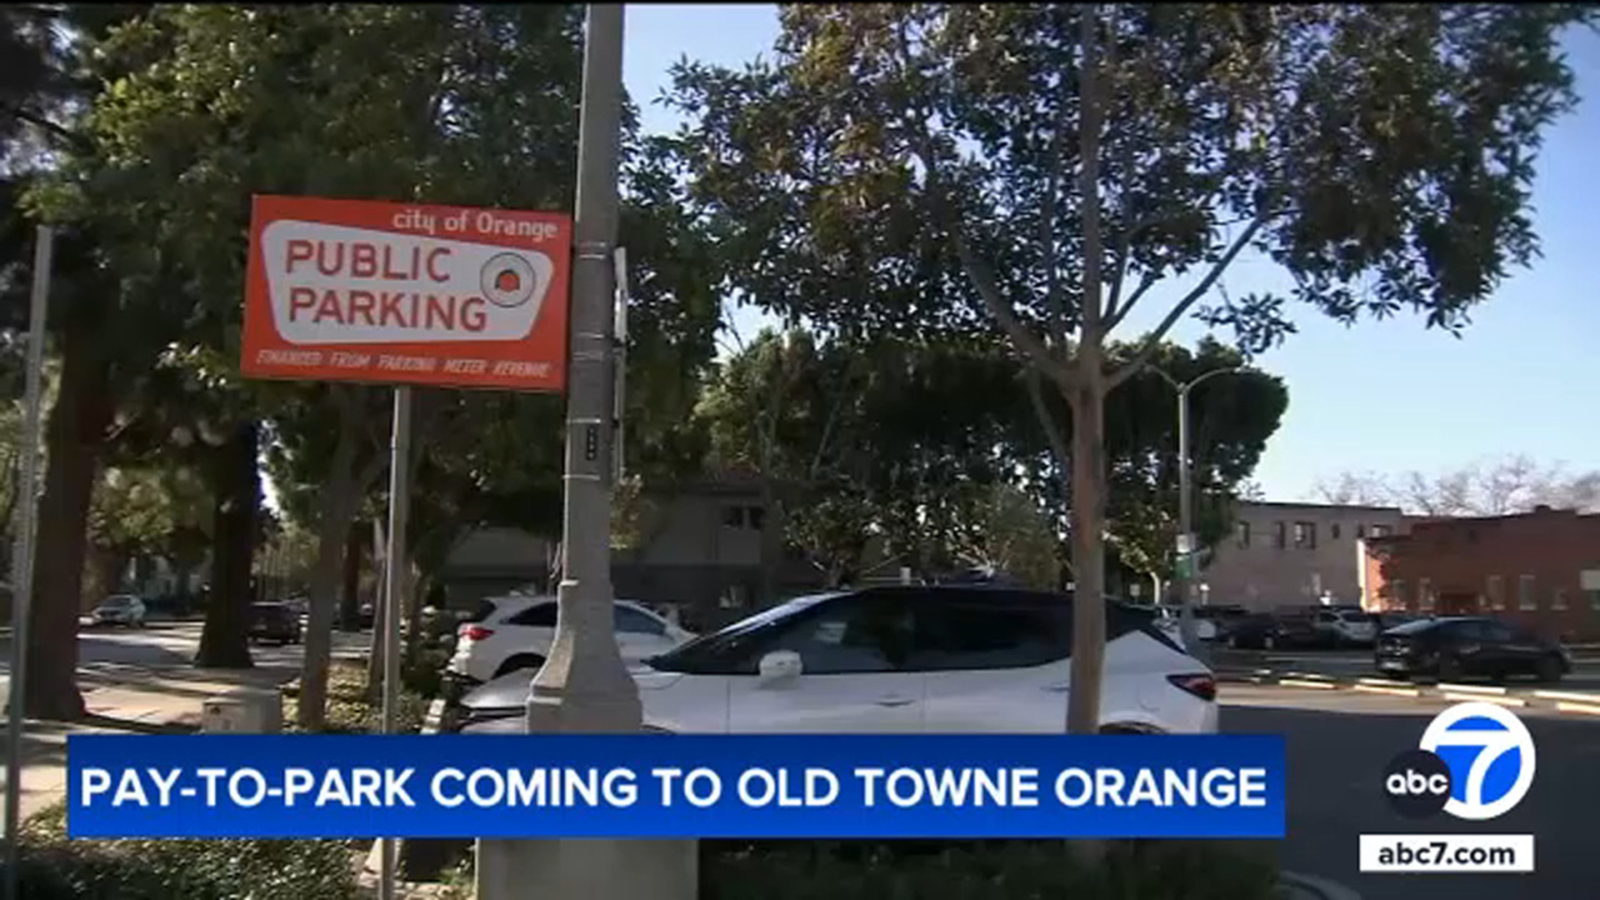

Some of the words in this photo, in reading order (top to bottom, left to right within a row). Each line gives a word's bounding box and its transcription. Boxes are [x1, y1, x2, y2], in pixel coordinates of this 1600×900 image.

[393, 209, 436, 235] city
[444, 210, 470, 232] of
[477, 211, 559, 243] Orange
[285, 239, 451, 283] PUBLIC
[288, 286, 487, 332] PARKING
[329, 351, 371, 369] FROM
[443, 358, 487, 375] METER
